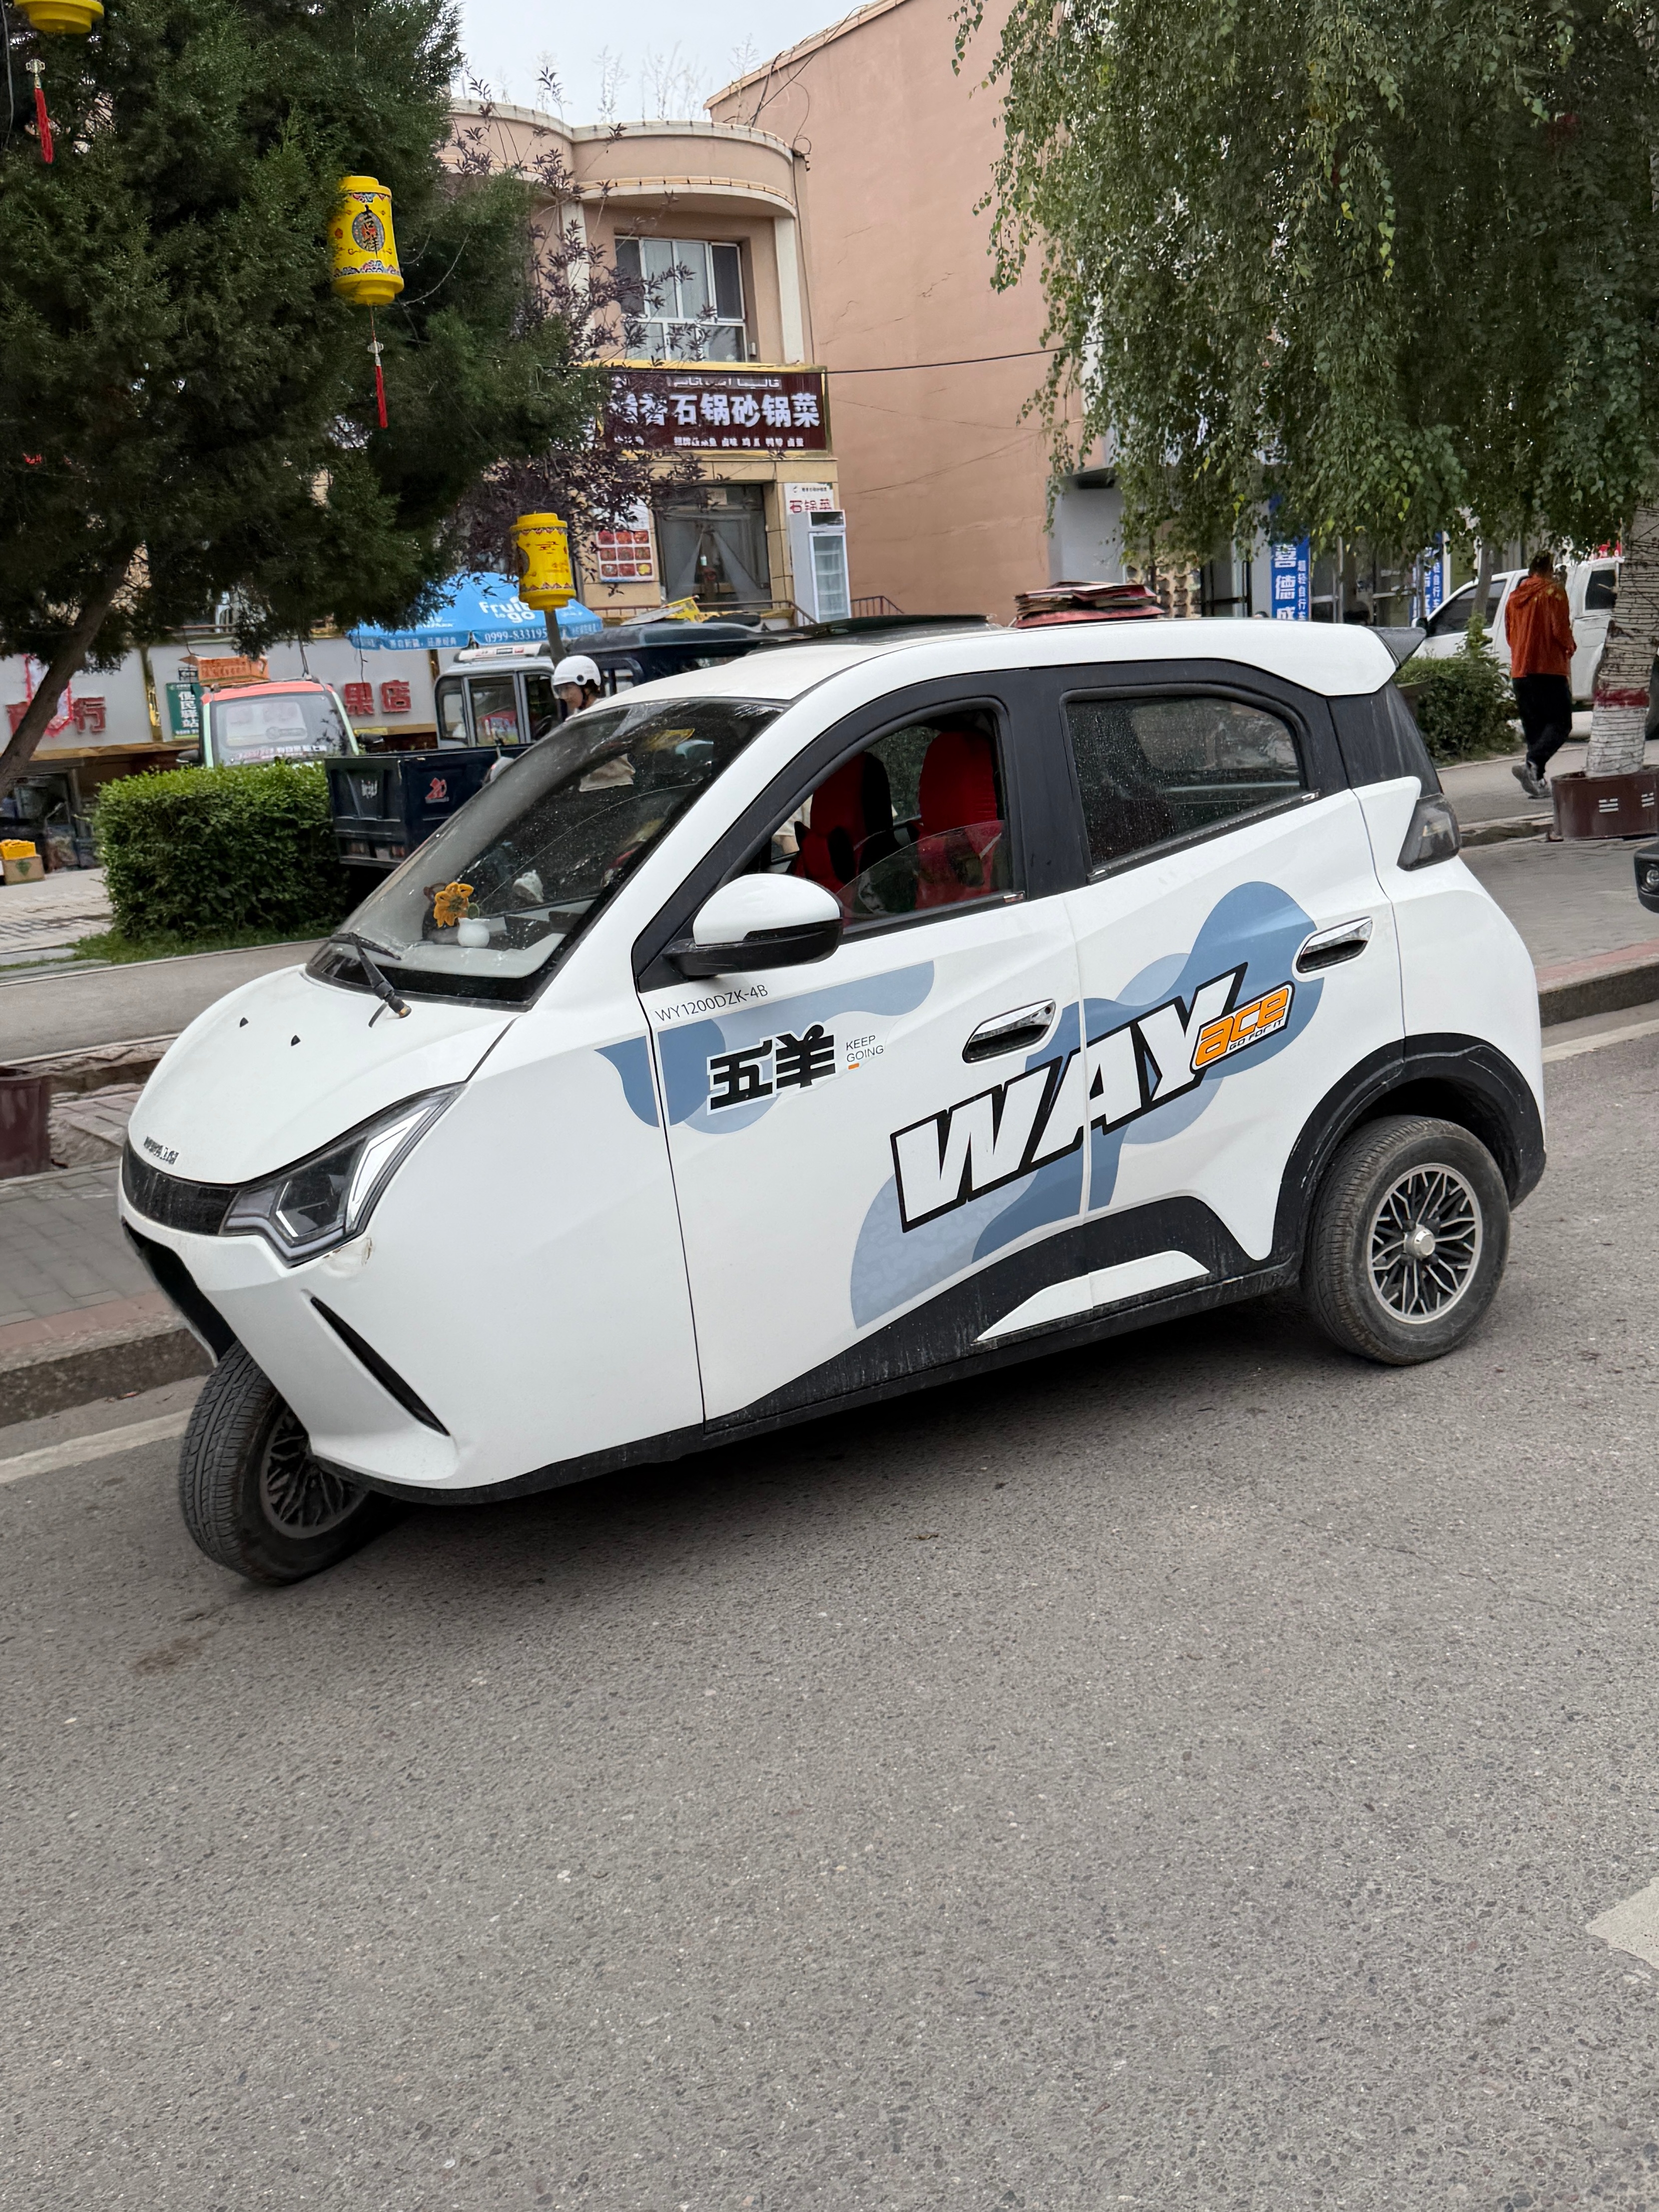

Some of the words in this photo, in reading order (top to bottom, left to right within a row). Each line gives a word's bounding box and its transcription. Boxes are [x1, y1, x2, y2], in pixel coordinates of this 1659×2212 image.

[479, 596, 530, 614] Fruit
[507, 610, 536, 624] go
[654, 984, 768, 1022] WY1200DZK-4B
[846, 1035, 876, 1051] KEEP
[1195, 988, 1289, 1067] ace
[1229, 1038, 1246, 1051] GO
[1273, 1018, 1283, 1029] IT
[710, 1024, 835, 1110] 五羊
[847, 1045, 884, 1063] GOING
[890, 962, 1248, 1233] WAY
